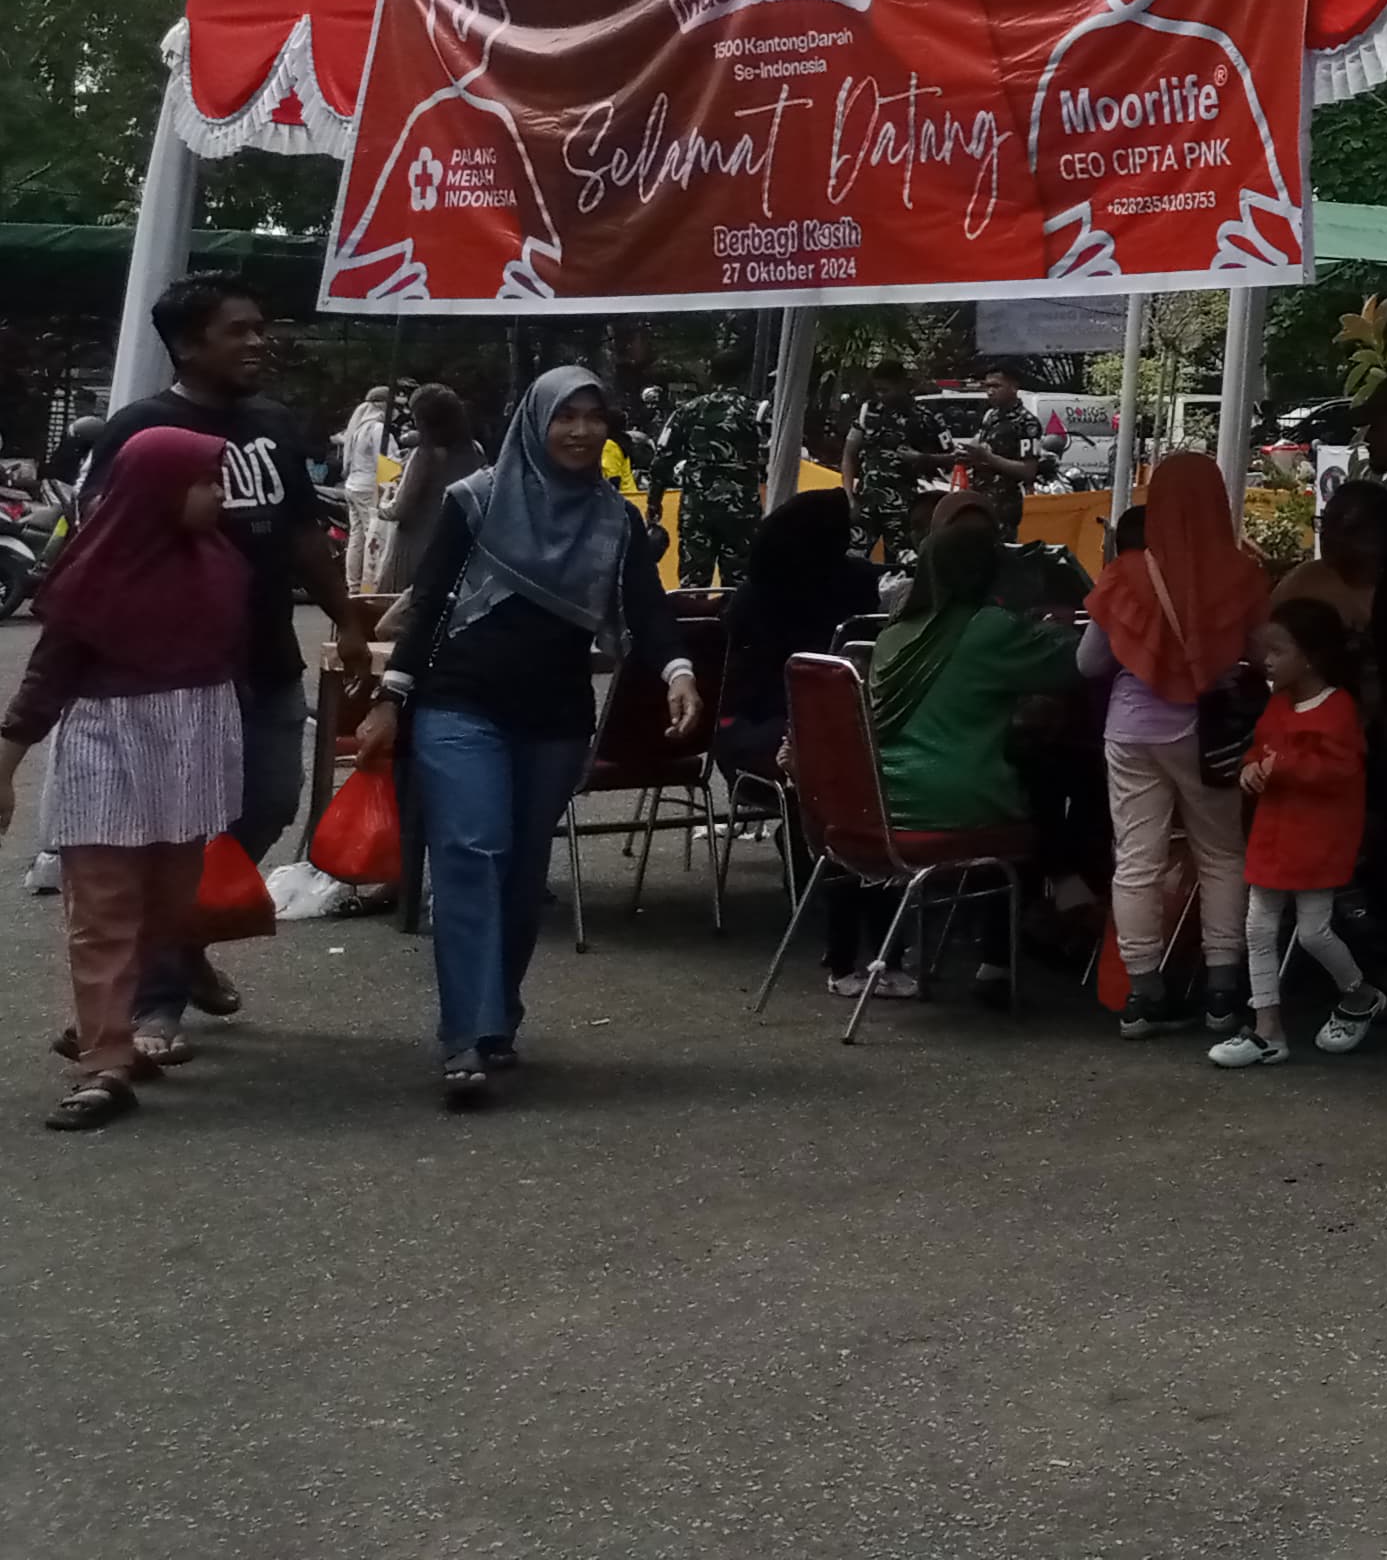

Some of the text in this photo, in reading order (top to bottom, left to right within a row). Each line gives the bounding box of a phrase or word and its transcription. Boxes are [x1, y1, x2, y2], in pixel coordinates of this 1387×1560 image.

[713, 28, 853, 59] 1500 Kantong Darah
[734, 57, 827, 81] Se-Indonesia
[450, 147, 497, 166] PALANG
[563, 72, 1012, 240] Selamat Datang
[1060, 138, 1232, 181] CEO CIPTA PNK
[446, 169, 494, 187] MERAH
[444, 189, 518, 208] INDONESIA
[714, 216, 861, 258] Berbagi Kasih
[722, 257, 857, 284] 27 Oktober 2024
